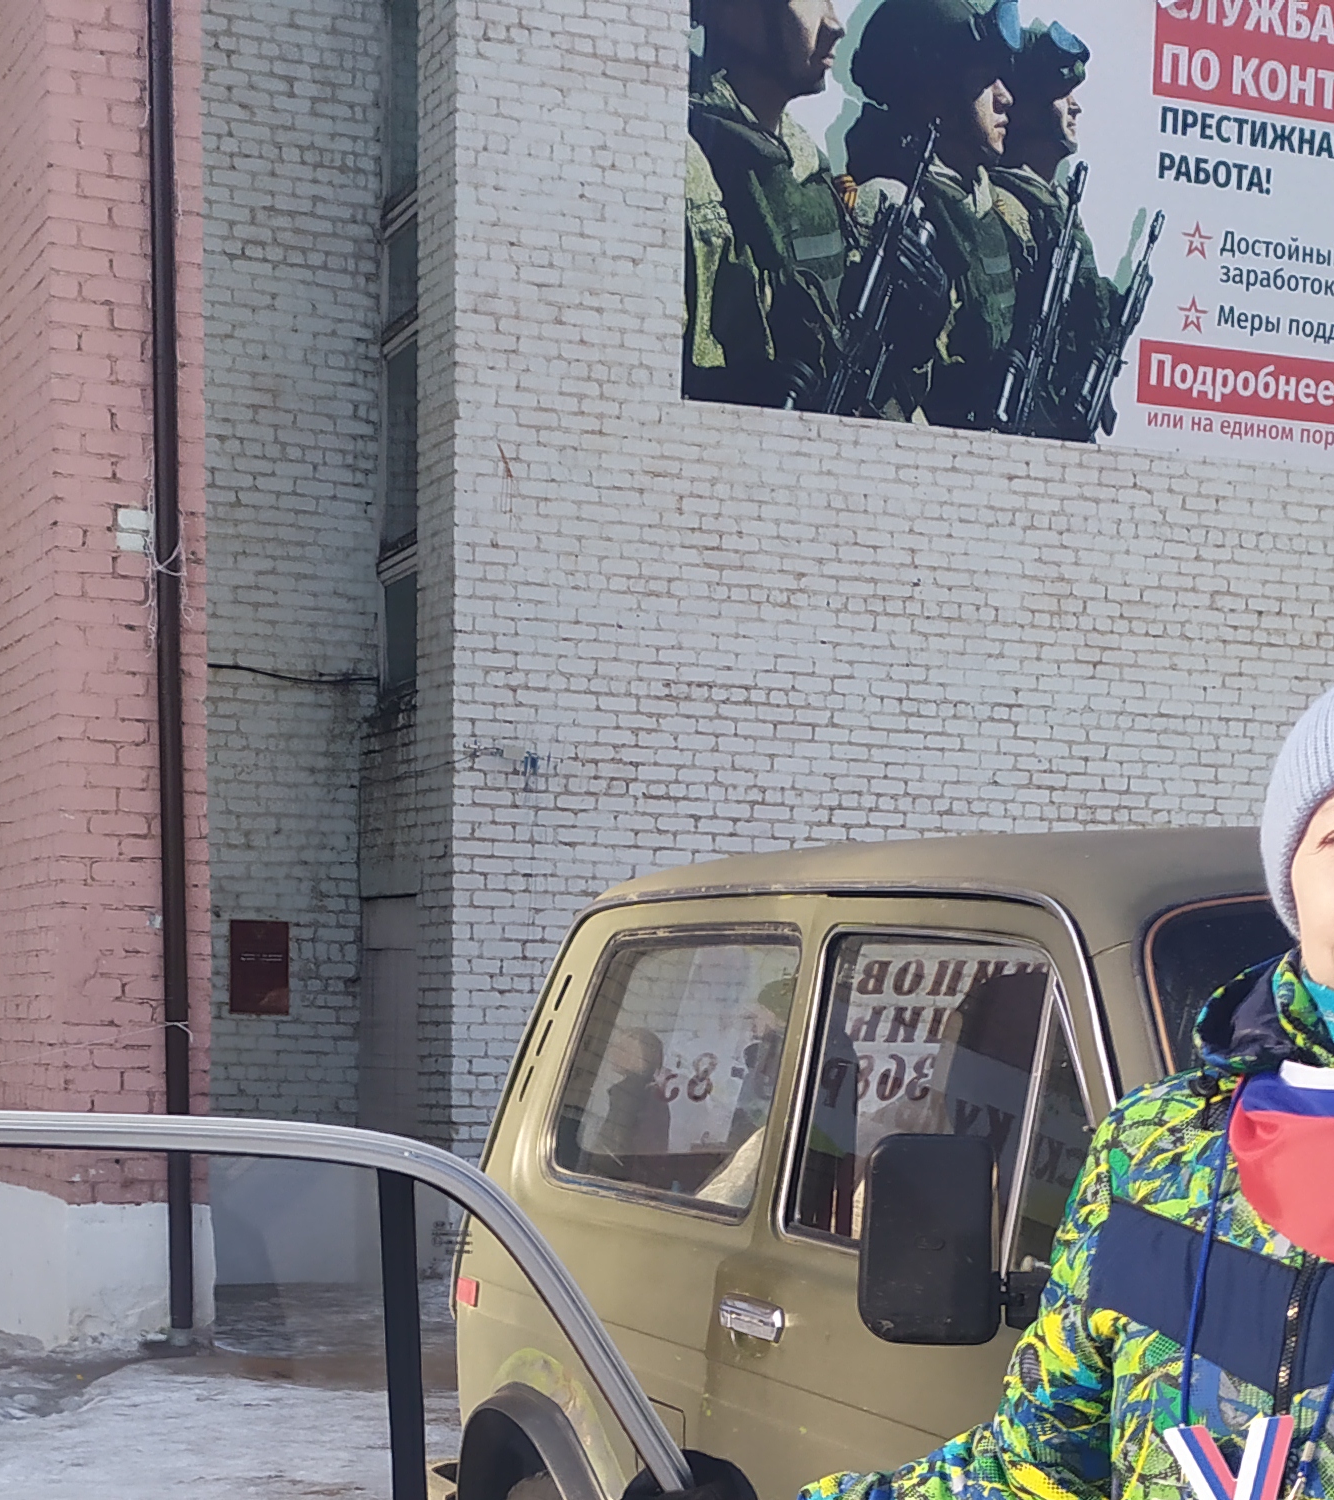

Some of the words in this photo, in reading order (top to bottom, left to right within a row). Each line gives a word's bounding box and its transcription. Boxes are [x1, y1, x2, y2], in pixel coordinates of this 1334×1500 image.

[1161, 43, 1221, 90] ПО
[1157, 152, 1273, 196] РАБОТА!
[1217, 304, 1281, 336] Меры
[1147, 411, 1184, 430] или
[1191, 415, 1214, 432] на
[1220, 418, 1294, 443] едином
